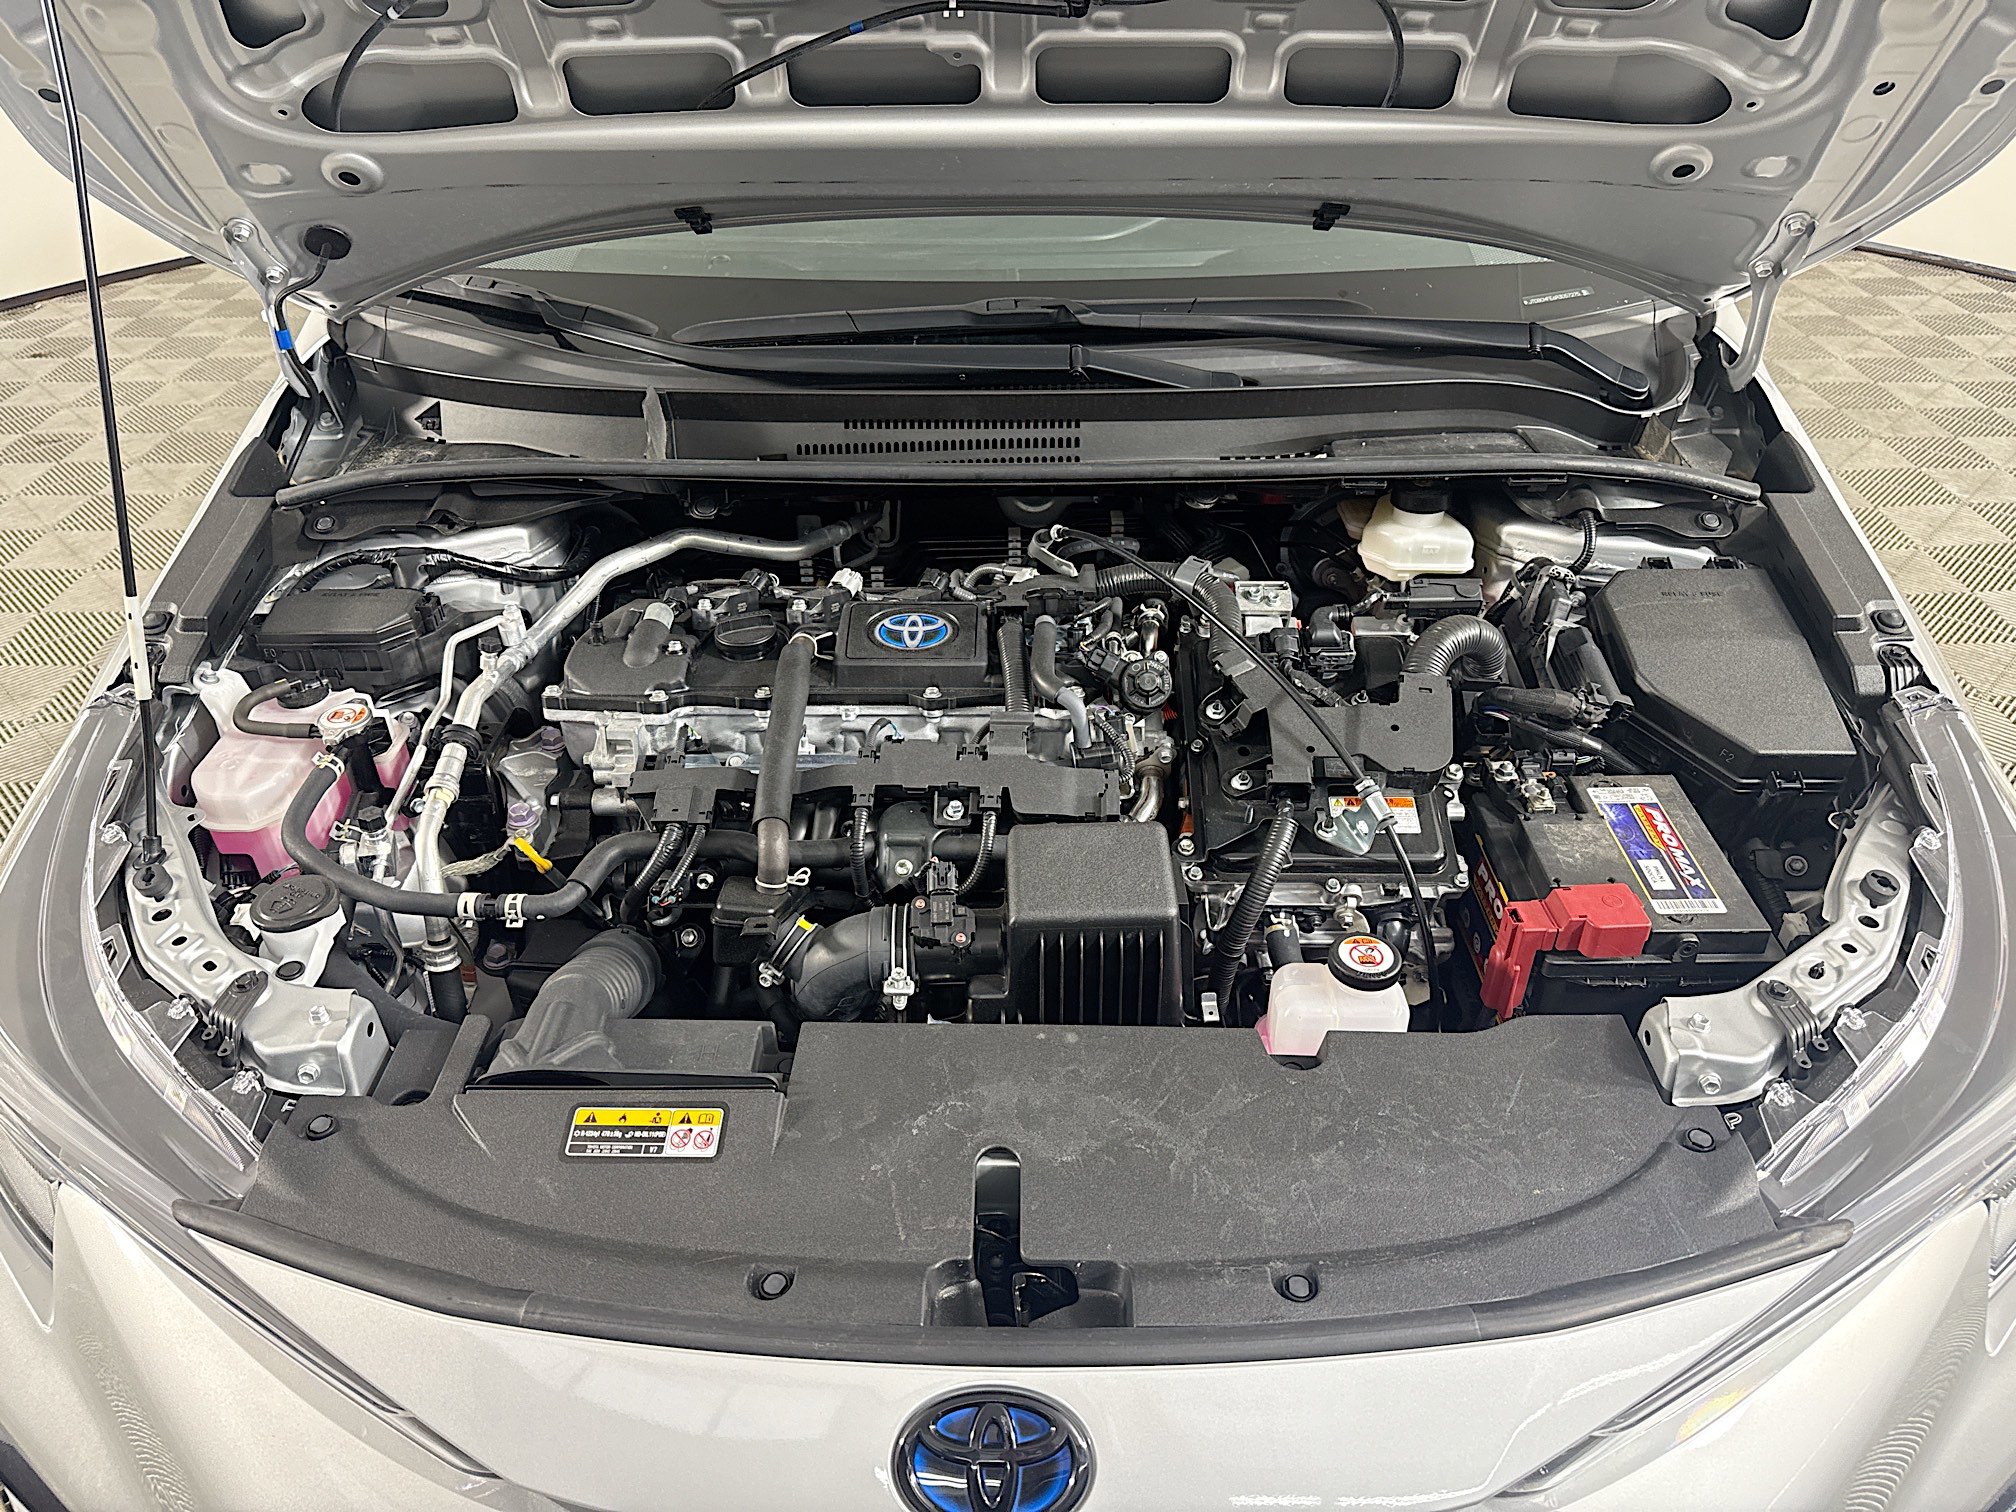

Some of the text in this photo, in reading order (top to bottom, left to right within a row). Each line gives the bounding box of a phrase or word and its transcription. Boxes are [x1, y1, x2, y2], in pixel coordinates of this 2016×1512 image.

[1719, 748, 1735, 763] F2
[1635, 806, 1663, 847] BATTERY
[1645, 806, 1706, 890] PROMAX
[1476, 862, 1504, 920] PRO
